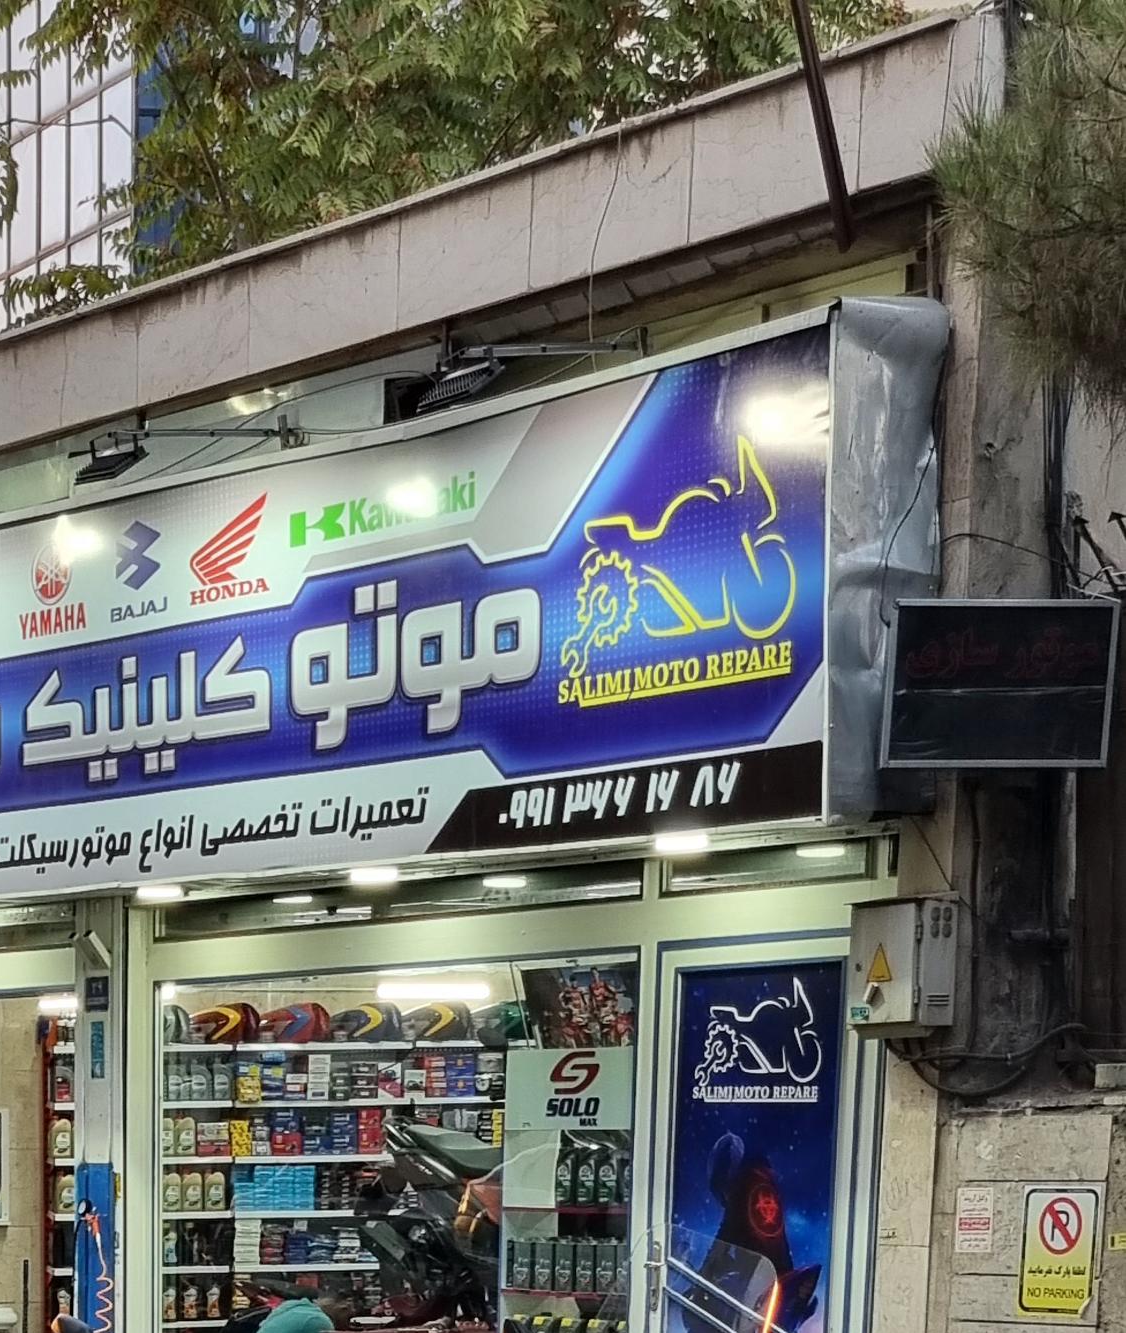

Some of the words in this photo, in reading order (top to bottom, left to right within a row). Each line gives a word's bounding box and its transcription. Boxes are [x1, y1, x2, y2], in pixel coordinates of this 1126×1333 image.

[110, 596, 168, 623] BAJAJ
[189, 577, 270, 606] HONDA
[19, 602, 87, 641] YAMAHA
[290, 579, 541, 752] موتو
[558, 669, 632, 705] SALIMI
[633, 658, 700, 691] MOTO
[706, 640, 793, 680] REPARE
[21, 635, 271, 783] کلینیک
[200, 802, 303, 857] تخصصی
[310, 786, 430, 841] تعمیرات
[138, 815, 195, 873] انواع
[545, 1096, 600, 1118] SOLO
[692, 1085, 733, 1100] SALIMI
[734, 1085, 770, 1099] MOTO
[773, 1085, 819, 1099] REPARE
[579, 1117, 598, 1127] MAX
[1027, 1287, 1042, 1298] NO
[1043, 1287, 1085, 1300] PARKING
